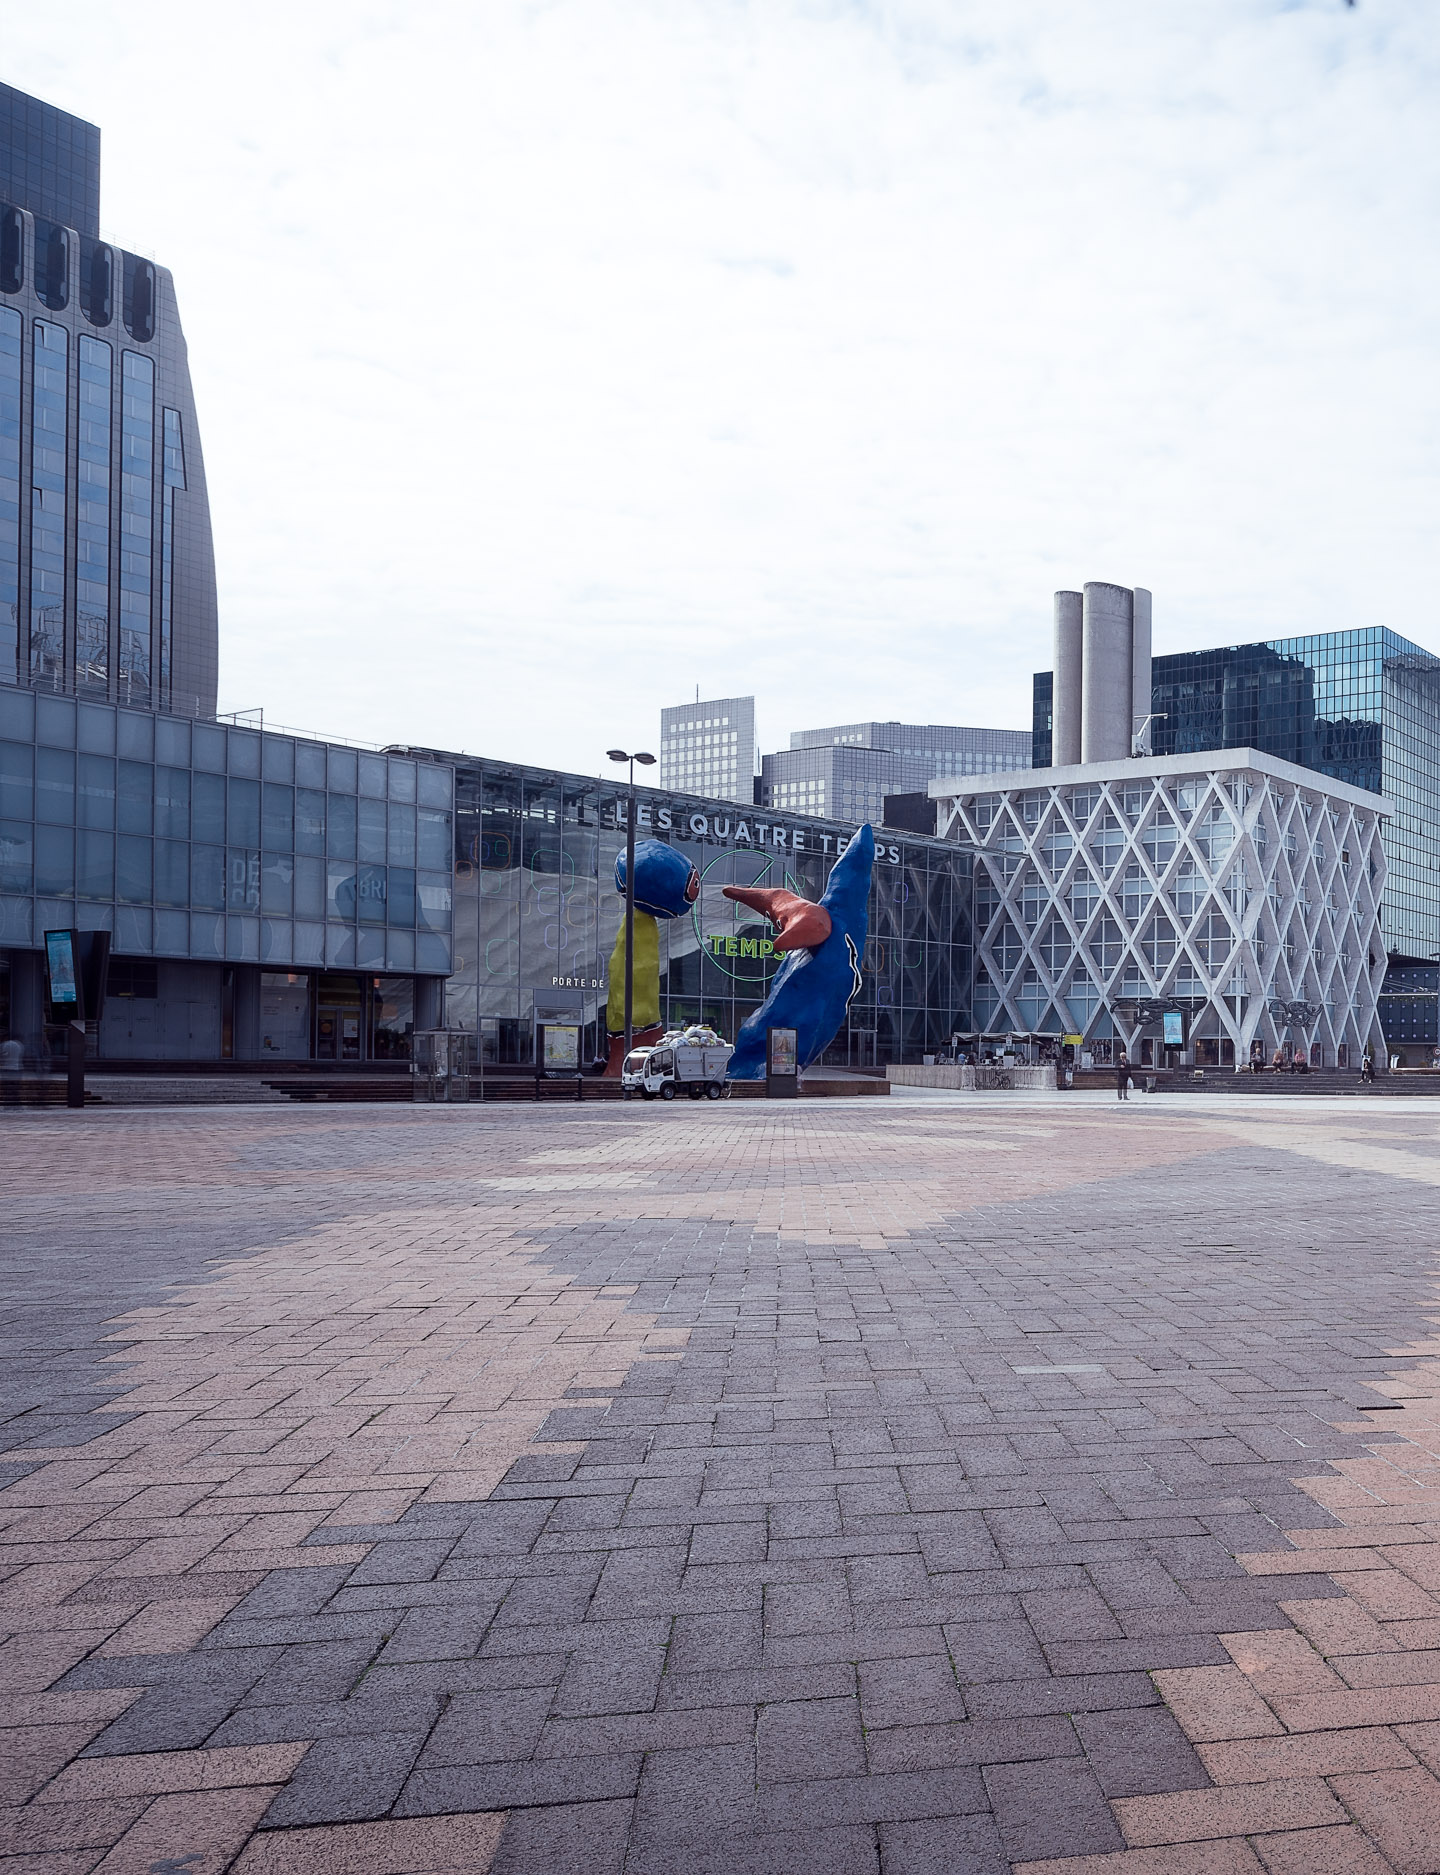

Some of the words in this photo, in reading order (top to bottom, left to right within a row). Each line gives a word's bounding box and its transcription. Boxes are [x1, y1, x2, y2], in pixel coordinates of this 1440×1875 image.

[616, 800, 672, 830] LES
[689, 813, 805, 850] QUATRE
[819, 834, 900, 865] TEPS
[552, 976, 586, 987] PORTE
[591, 979, 604, 988] DE
